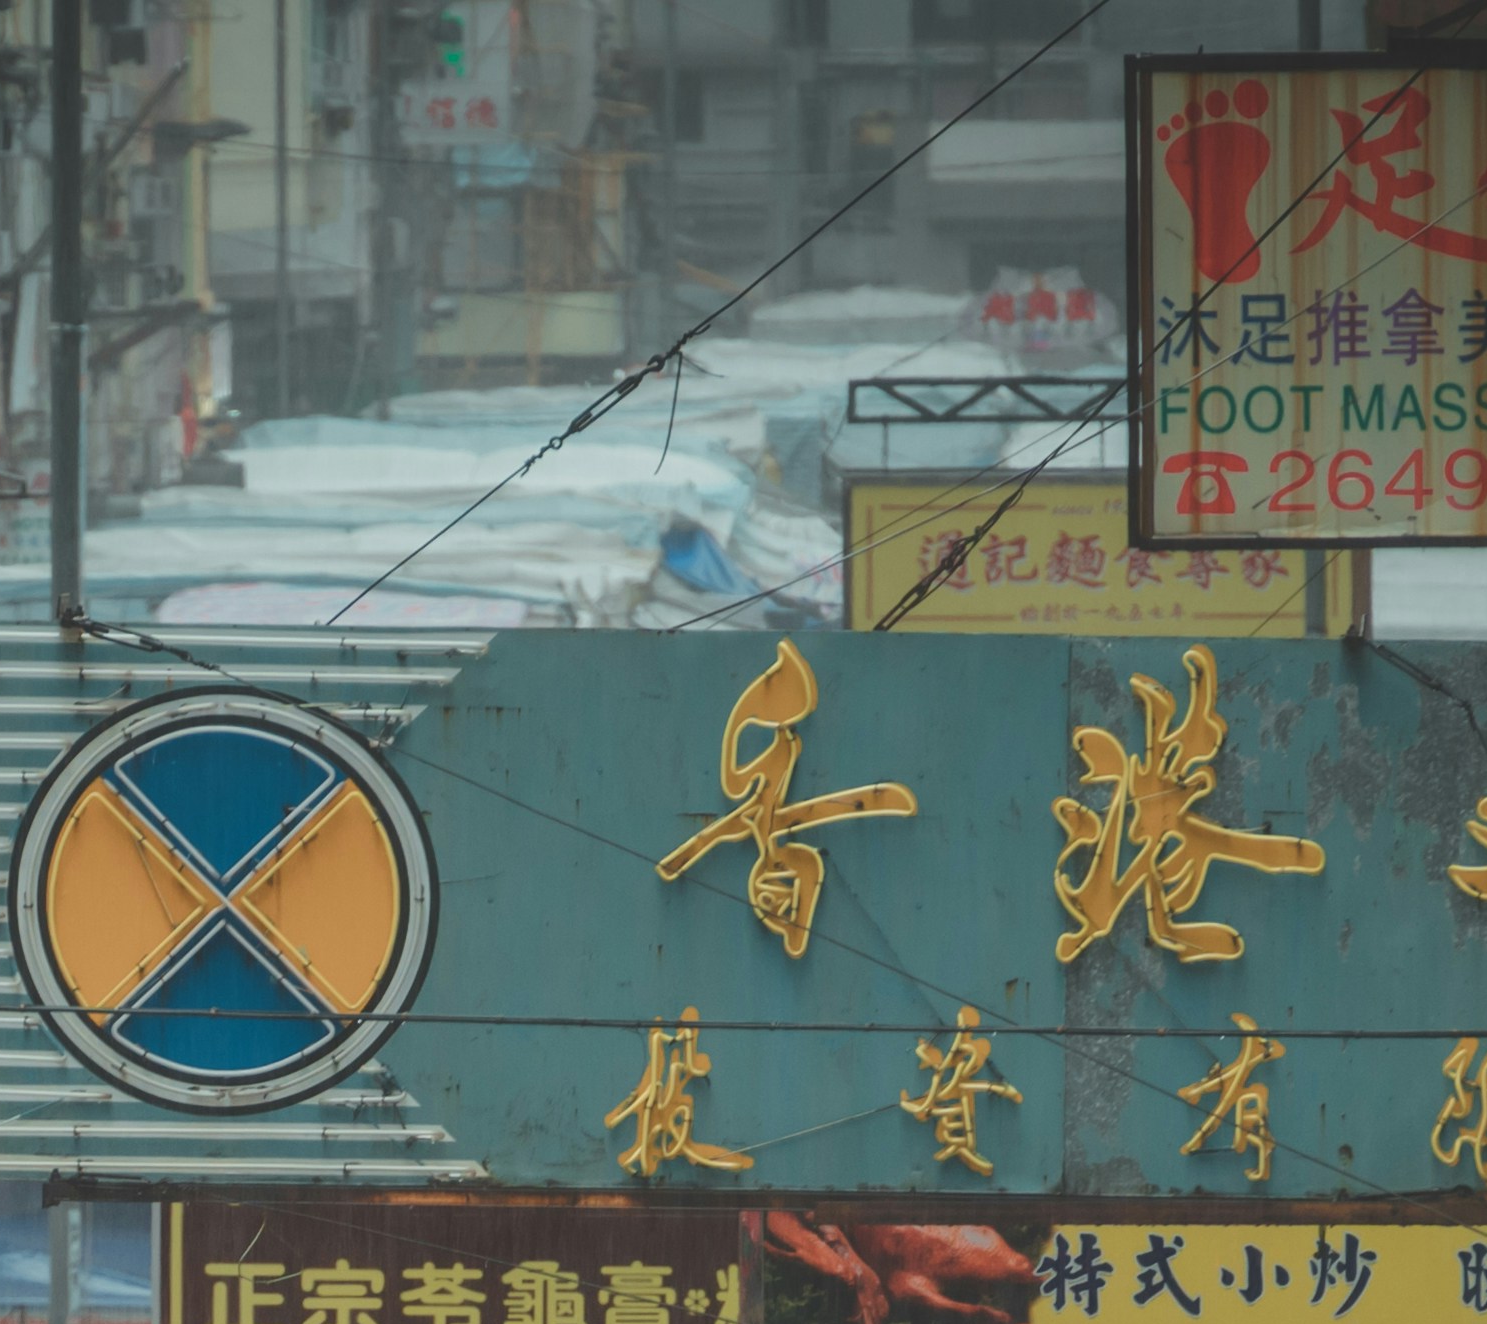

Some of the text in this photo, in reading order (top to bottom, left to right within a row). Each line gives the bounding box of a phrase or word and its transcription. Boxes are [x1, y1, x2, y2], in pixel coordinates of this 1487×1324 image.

[1159, 384, 1324, 435] FOOT
[1033, 1232, 1379, 1321] 特式小炒
